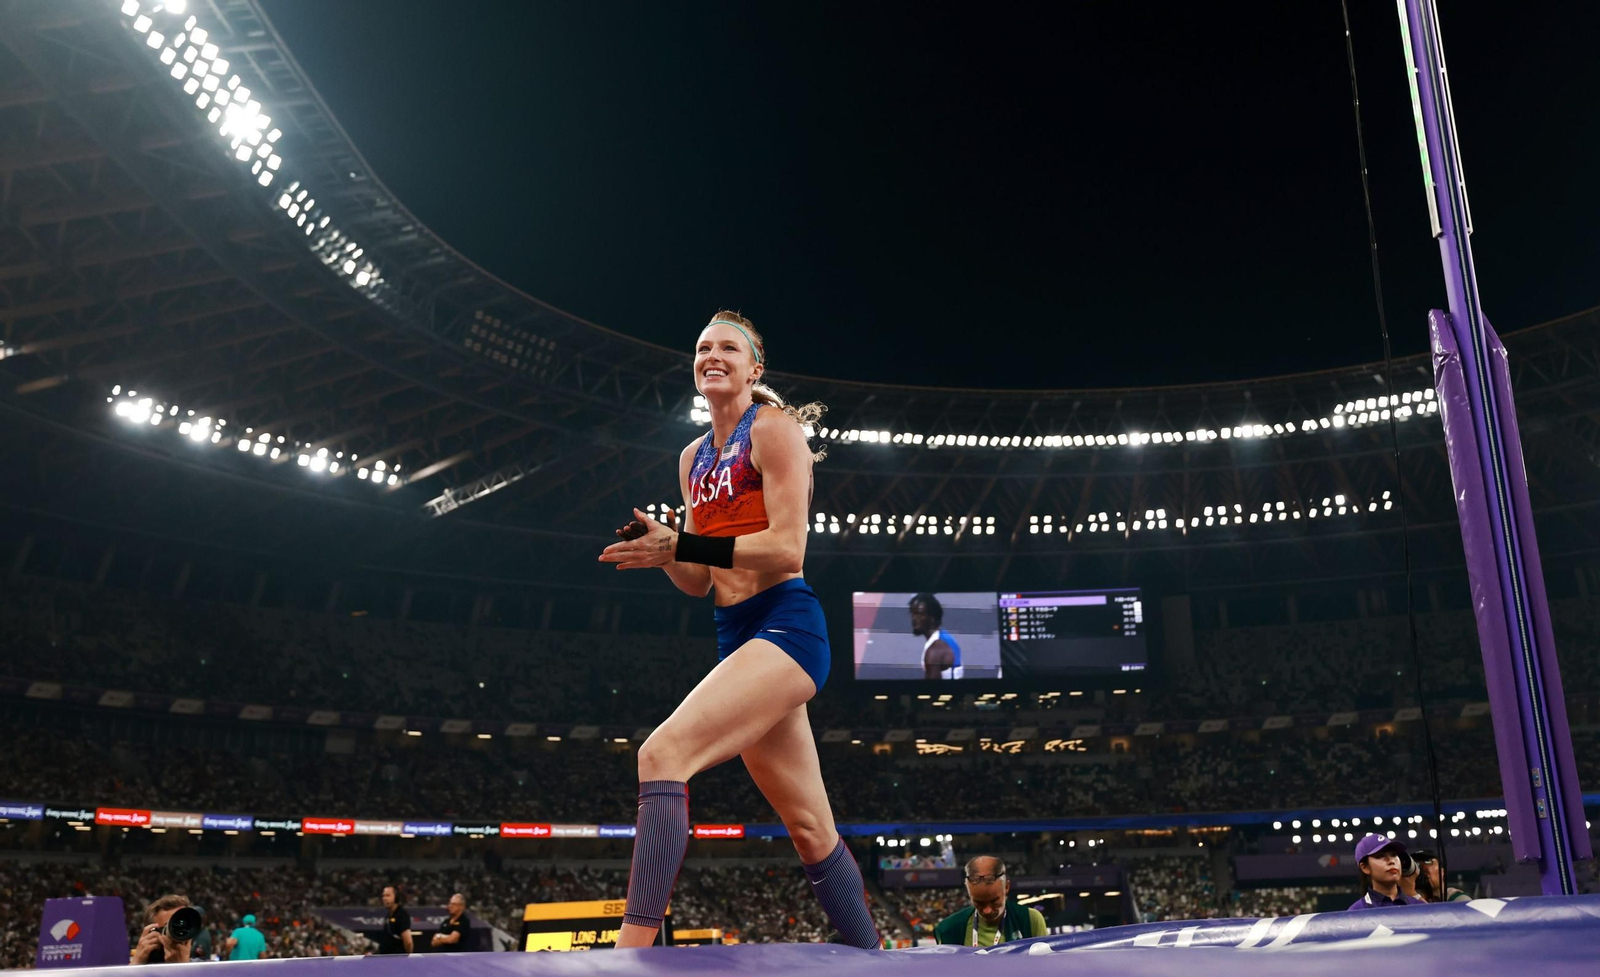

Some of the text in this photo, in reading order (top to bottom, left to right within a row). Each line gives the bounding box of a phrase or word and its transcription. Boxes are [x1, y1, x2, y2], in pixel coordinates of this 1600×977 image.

[691, 466, 734, 509] USA
[572, 929, 621, 944] LONG JUM
